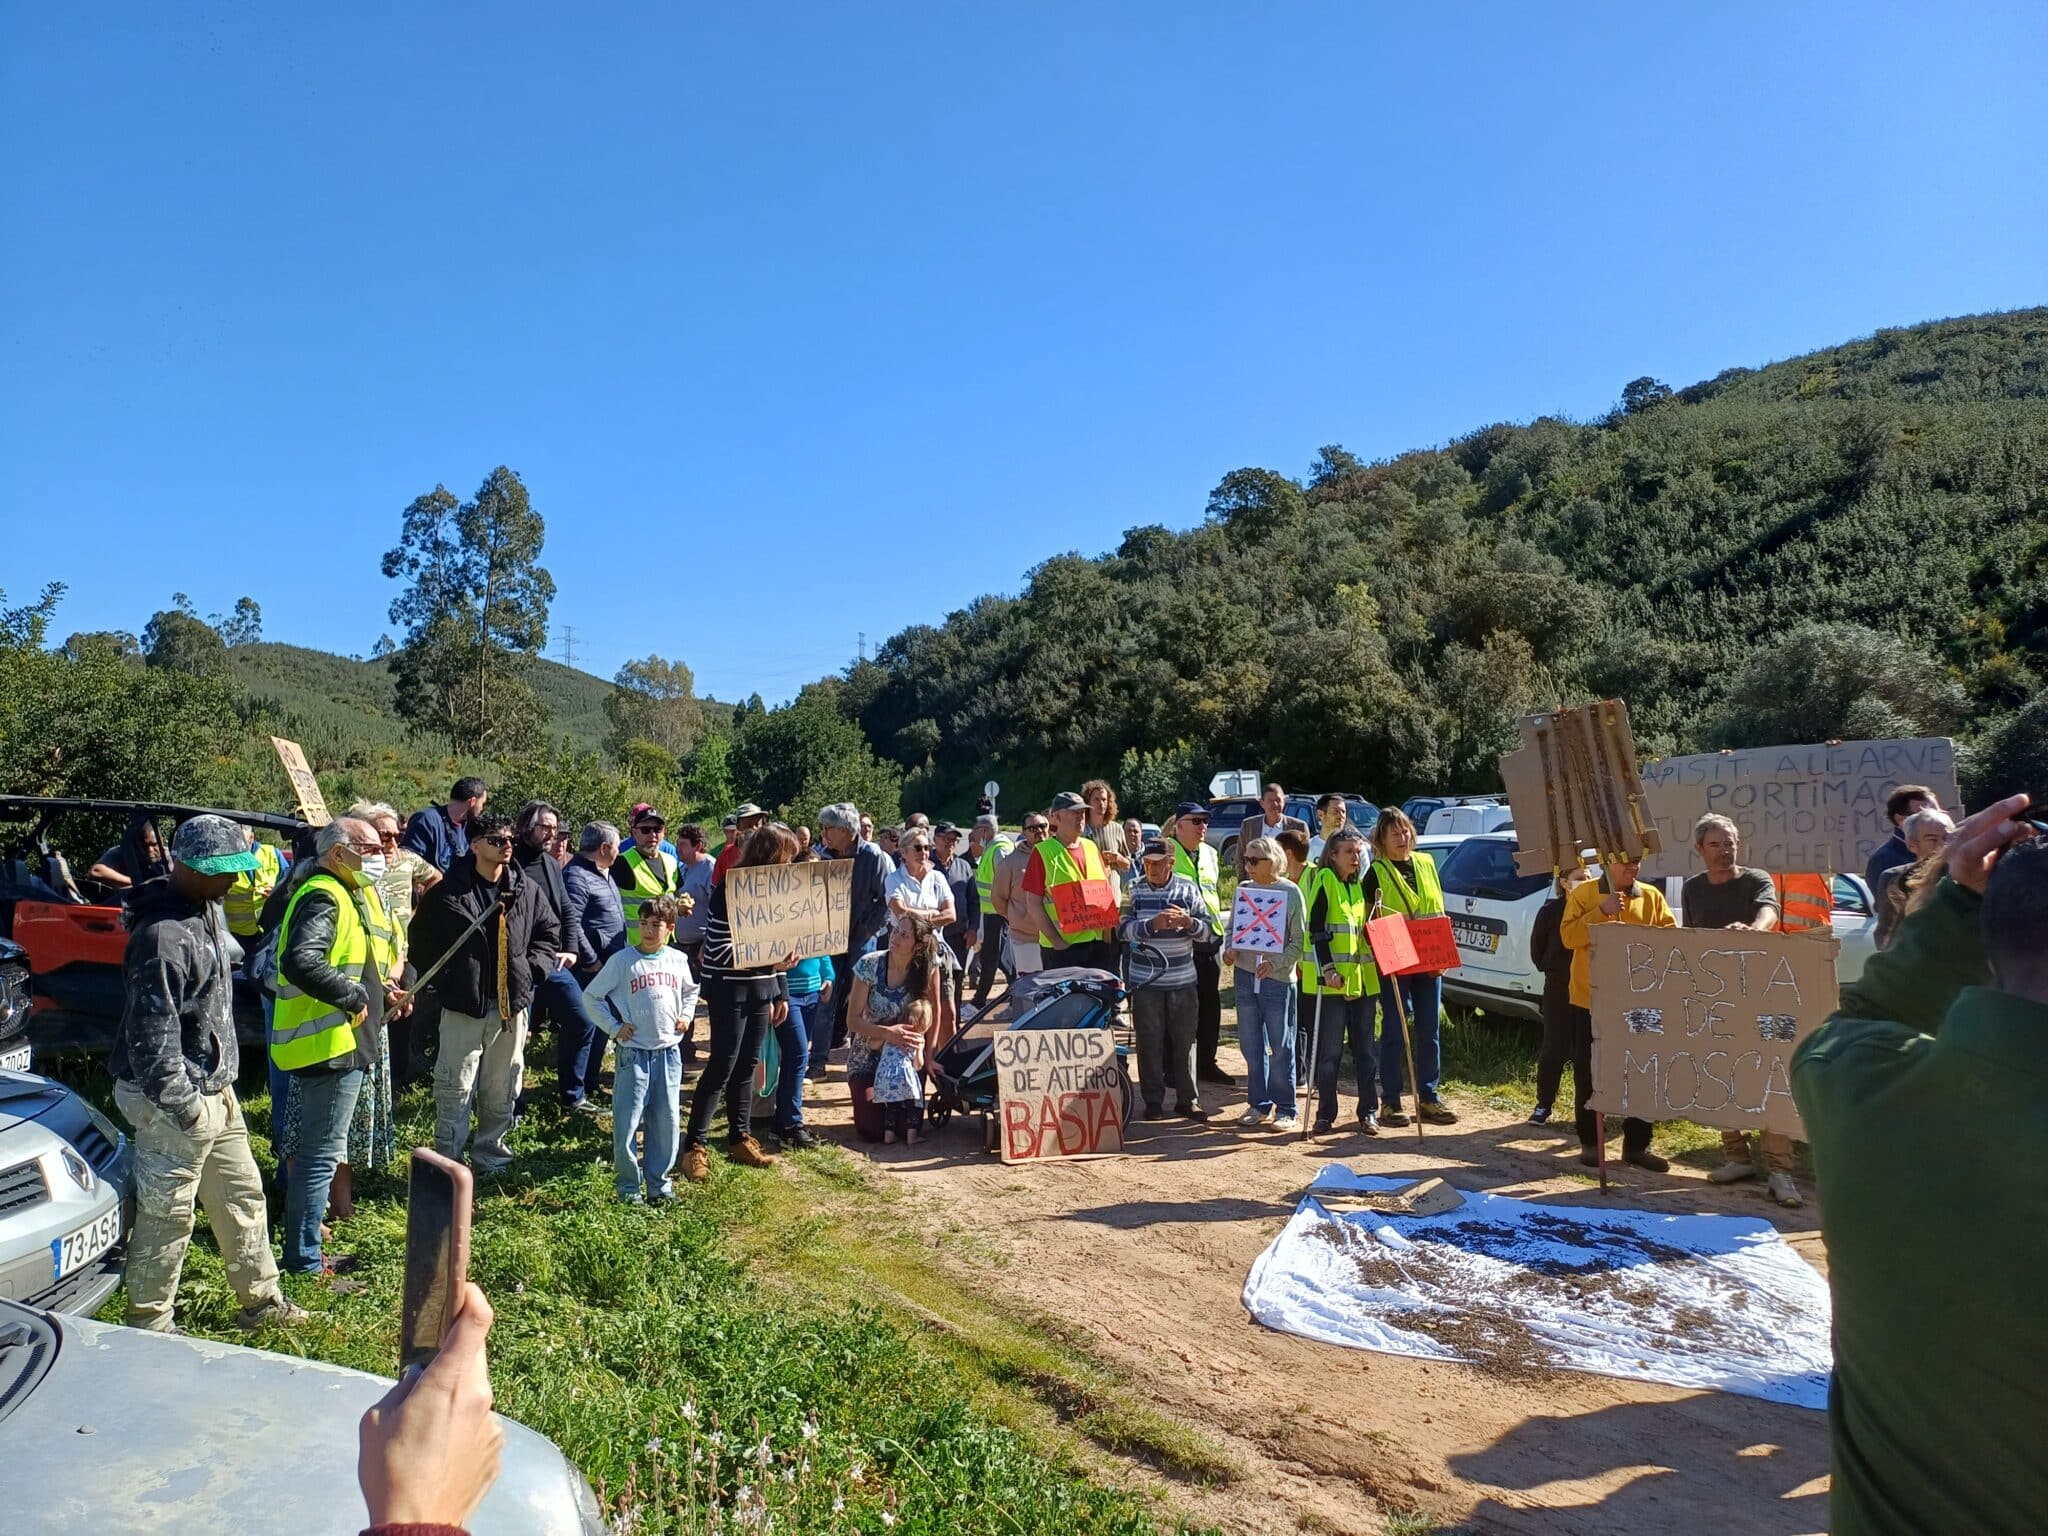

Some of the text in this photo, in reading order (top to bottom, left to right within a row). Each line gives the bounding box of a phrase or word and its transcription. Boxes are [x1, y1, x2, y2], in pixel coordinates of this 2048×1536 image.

[1775, 746, 1947, 777] ALGARVE
[1654, 809, 1817, 843] TUSMO
[1824, 815, 1847, 833] DE
[1764, 838, 1876, 870] CHEIR
[734, 867, 803, 899] MENOS
[735, 903, 785, 929] MAIS
[735, 942, 760, 966] FIM
[768, 940, 786, 960] AO
[630, 972, 679, 994] BOSTON
[1626, 943, 1802, 1006] BASTA
[1683, 997, 1736, 1039] DE
[996, 1032, 1104, 1067] 30 ANOS
[1013, 1064, 1119, 1093] DE ATERRO
[1005, 1091, 1124, 1159] BASTA
